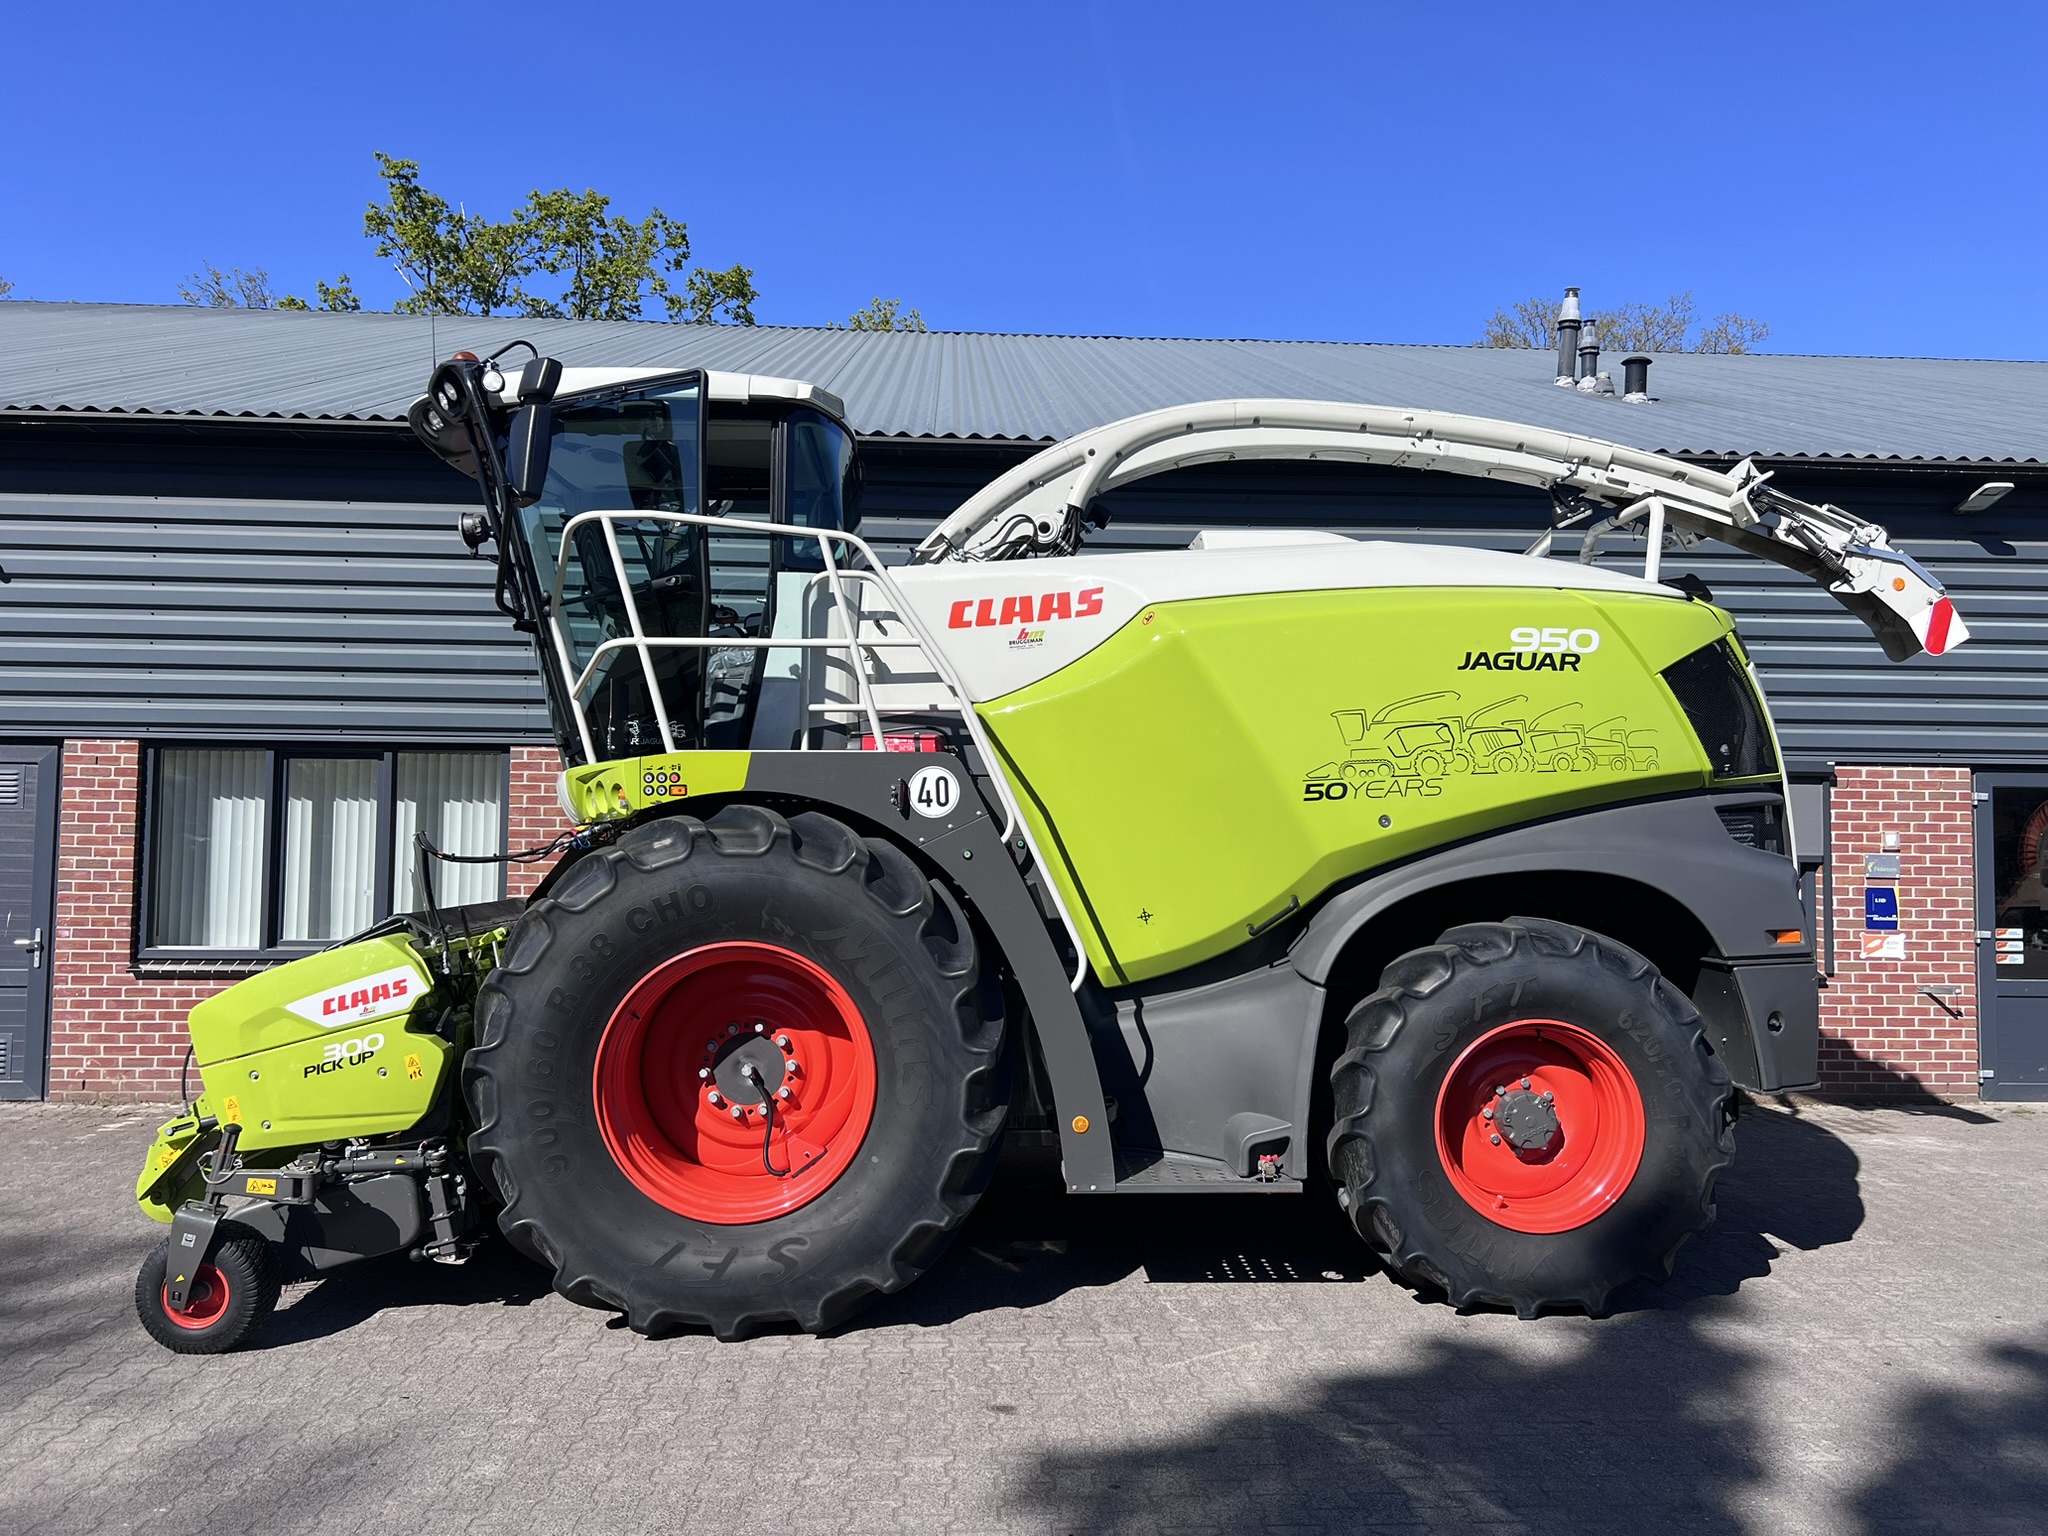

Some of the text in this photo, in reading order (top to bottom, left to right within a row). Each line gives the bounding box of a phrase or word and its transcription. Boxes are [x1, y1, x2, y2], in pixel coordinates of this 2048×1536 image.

[948, 586, 1104, 629] CLAAS
[1510, 627, 1600, 653] 950
[1457, 652, 1581, 672] JAGUAR
[917, 775, 949, 807] 40
[543, 985, 583, 1019] R
[569, 933, 619, 984] 38
[624, 883, 716, 937] CHO
[322, 978, 408, 1016] CLAAS
[323, 1033, 385, 1063] 300
[304, 1051, 374, 1078] PICK UP
